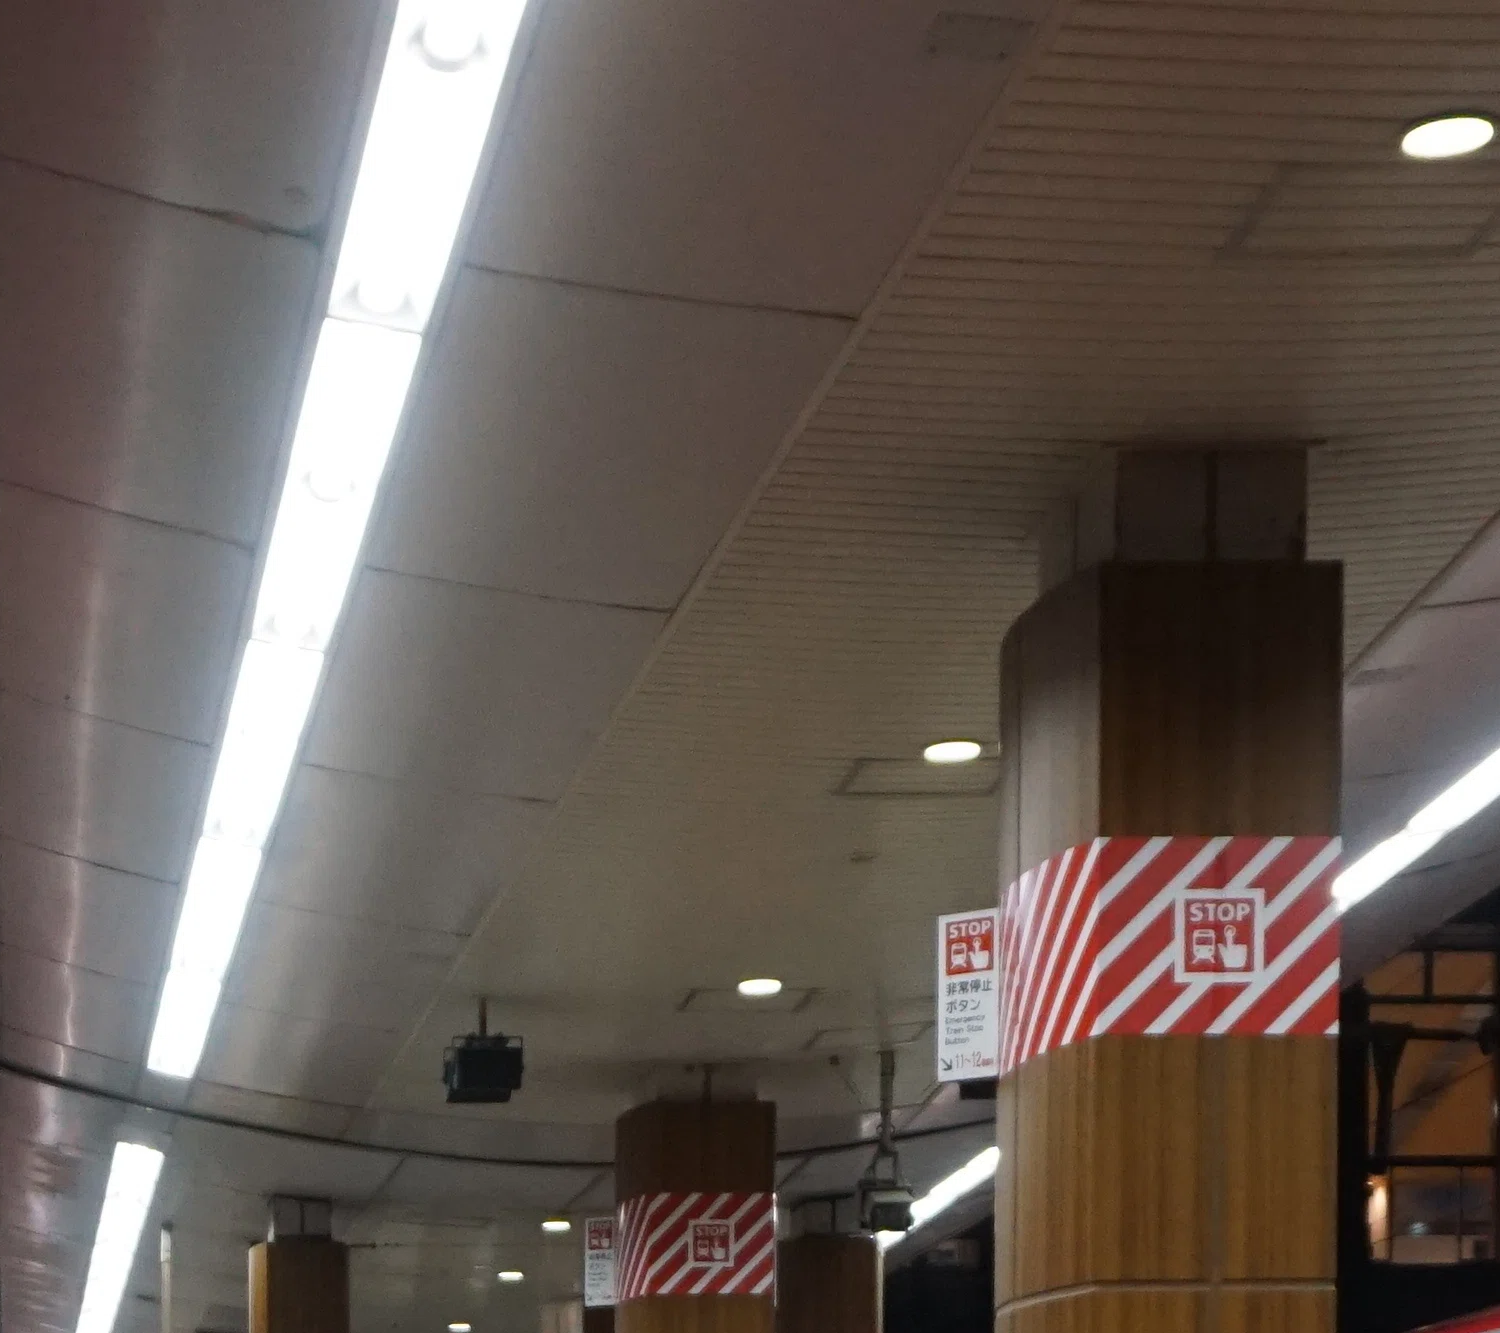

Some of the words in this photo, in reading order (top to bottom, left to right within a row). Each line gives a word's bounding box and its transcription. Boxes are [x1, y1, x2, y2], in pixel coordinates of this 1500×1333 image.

[1189, 902, 1250, 922] STOP
[949, 920, 991, 939] STOP
[946, 979, 993, 996] 非常停止
[946, 1000, 980, 1013] ボタン
[695, 1225, 728, 1237] STOP
